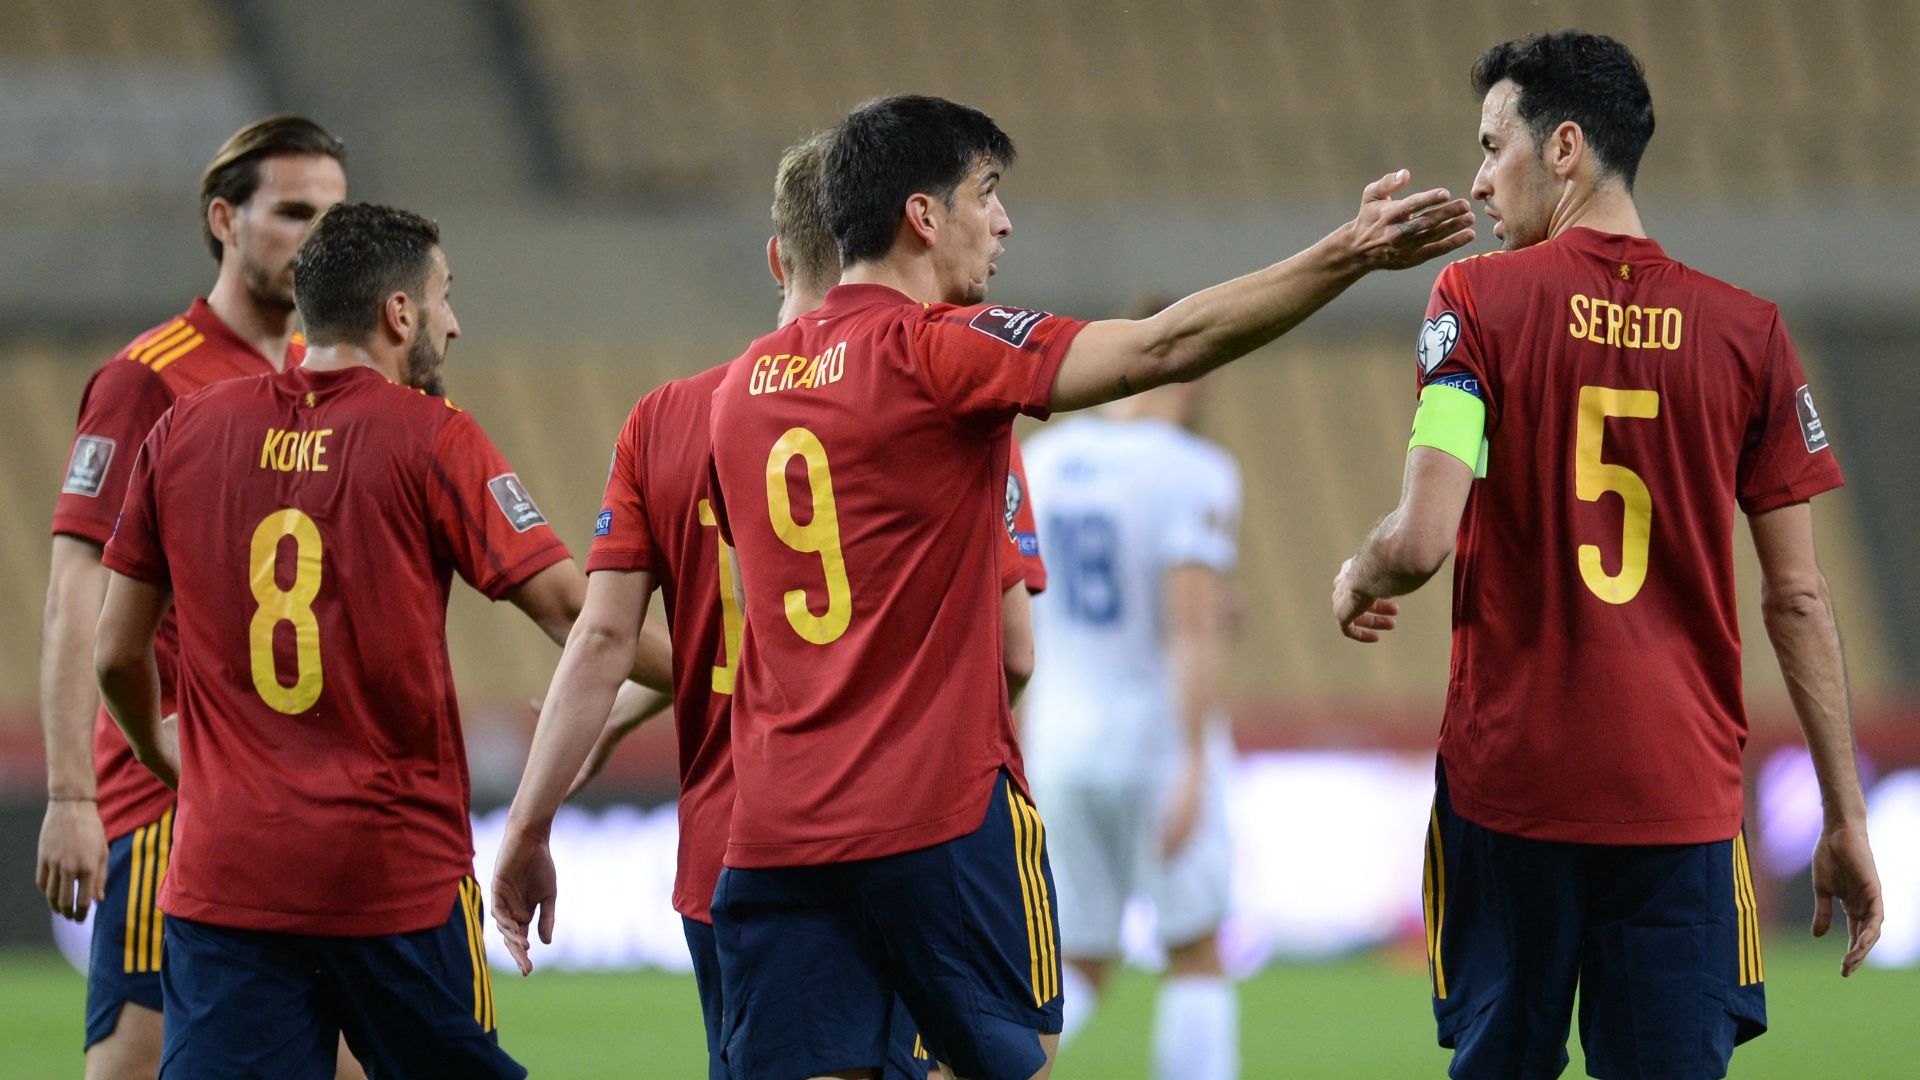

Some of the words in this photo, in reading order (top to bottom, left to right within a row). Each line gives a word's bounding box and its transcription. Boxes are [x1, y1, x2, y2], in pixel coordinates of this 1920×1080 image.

[749, 341, 847, 395] GERARD
[1570, 294, 1682, 350] SERGIO
[260, 428, 333, 472] KOKE
[1576, 385, 1659, 605] 5
[766, 427, 852, 645] 9
[250, 508, 323, 714] 8
